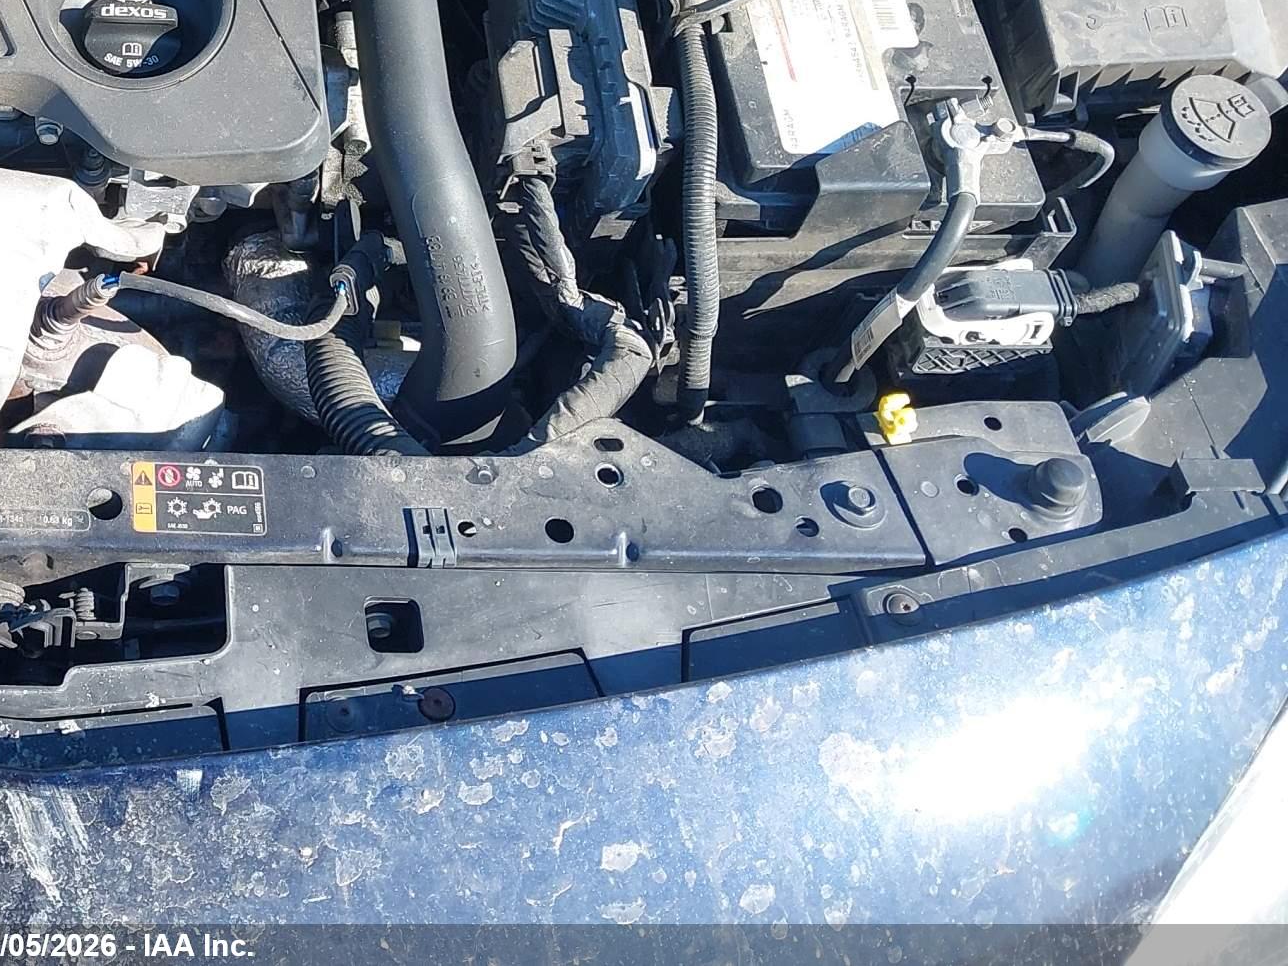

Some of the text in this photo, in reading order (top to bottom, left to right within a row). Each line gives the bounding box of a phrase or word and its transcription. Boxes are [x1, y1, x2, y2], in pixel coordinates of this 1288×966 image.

[100, 3, 168, 19] dexos
[103, 52, 160, 68] SAE 5W-30
[185, 480, 203, 488] AUTO
[226, 505, 248, 515] PAG
